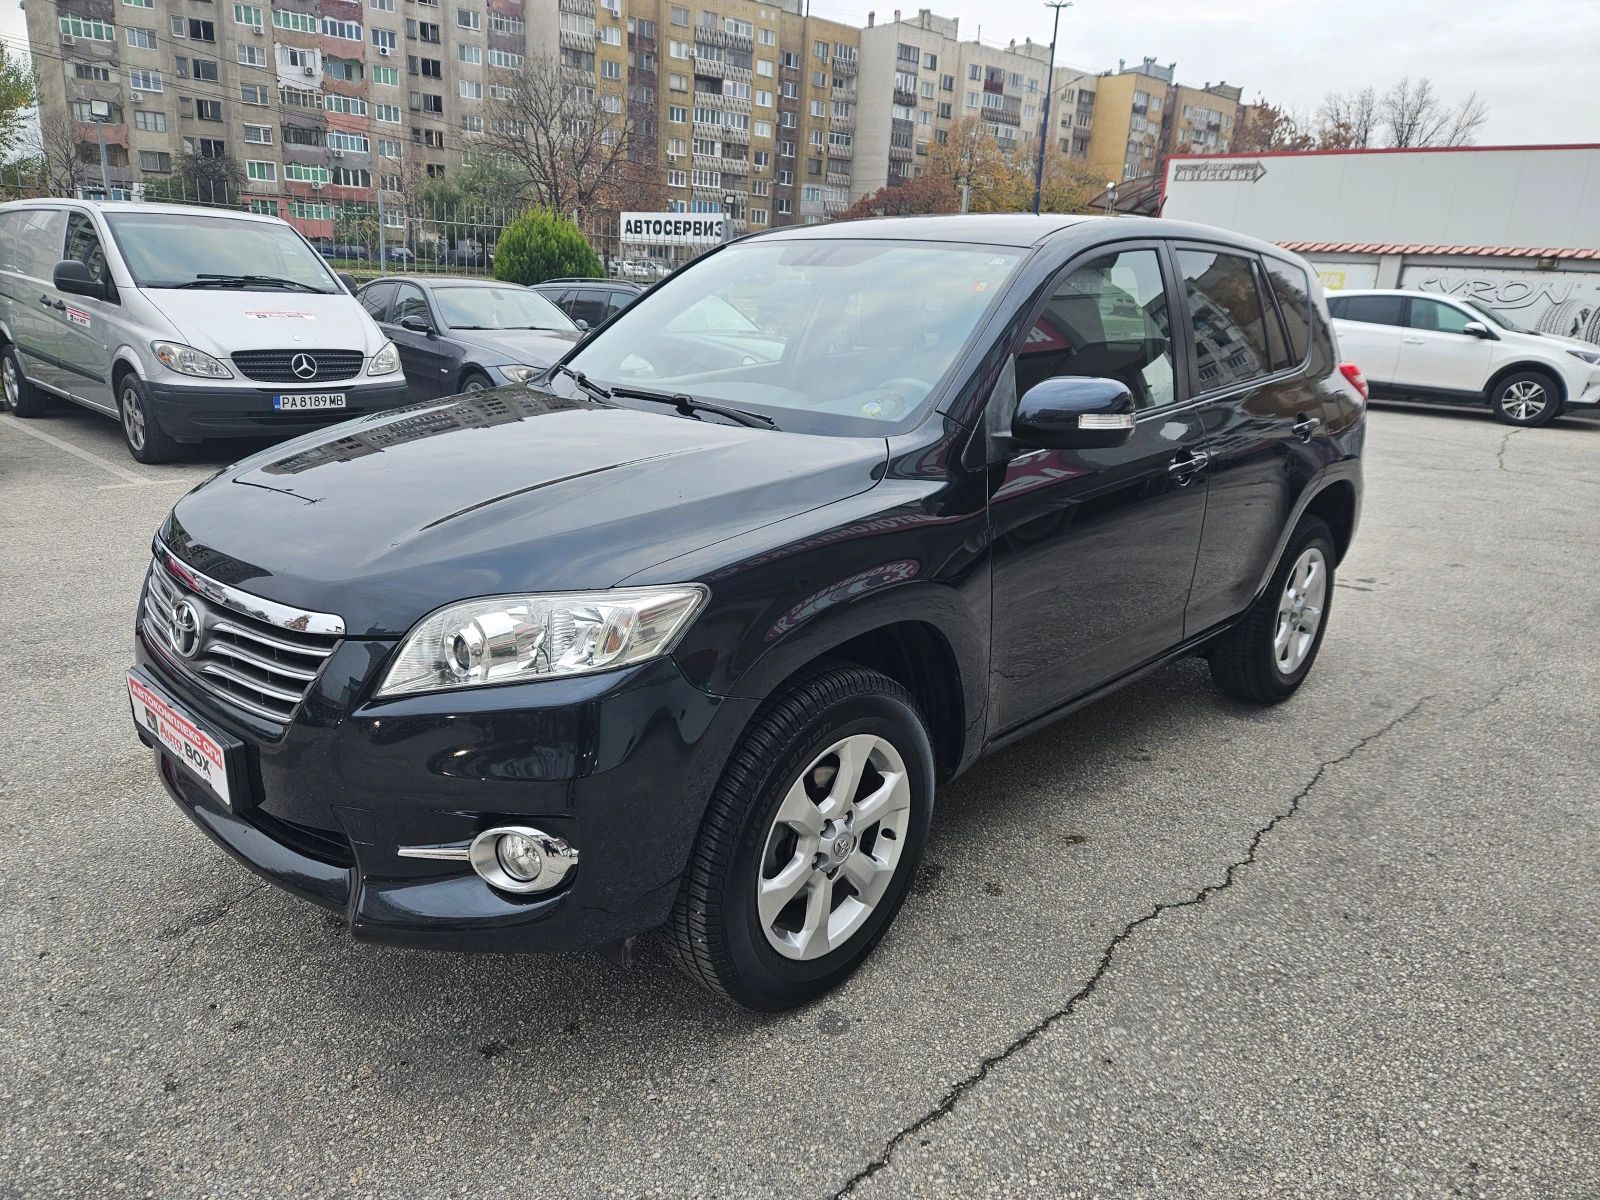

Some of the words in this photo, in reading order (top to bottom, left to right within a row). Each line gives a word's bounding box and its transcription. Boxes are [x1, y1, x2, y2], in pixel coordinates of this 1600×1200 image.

[1176, 169, 1255, 180] АВТОСЕРВИЗ
[624, 219, 723, 237] АВТОСЕРВИЗ
[282, 396, 298, 408] PA
[300, 395, 327, 408] 8189
[329, 395, 344, 406] MB
[132, 684, 202, 746] АВТОКОМПЛЕКС
[184, 740, 211, 777] BOX
